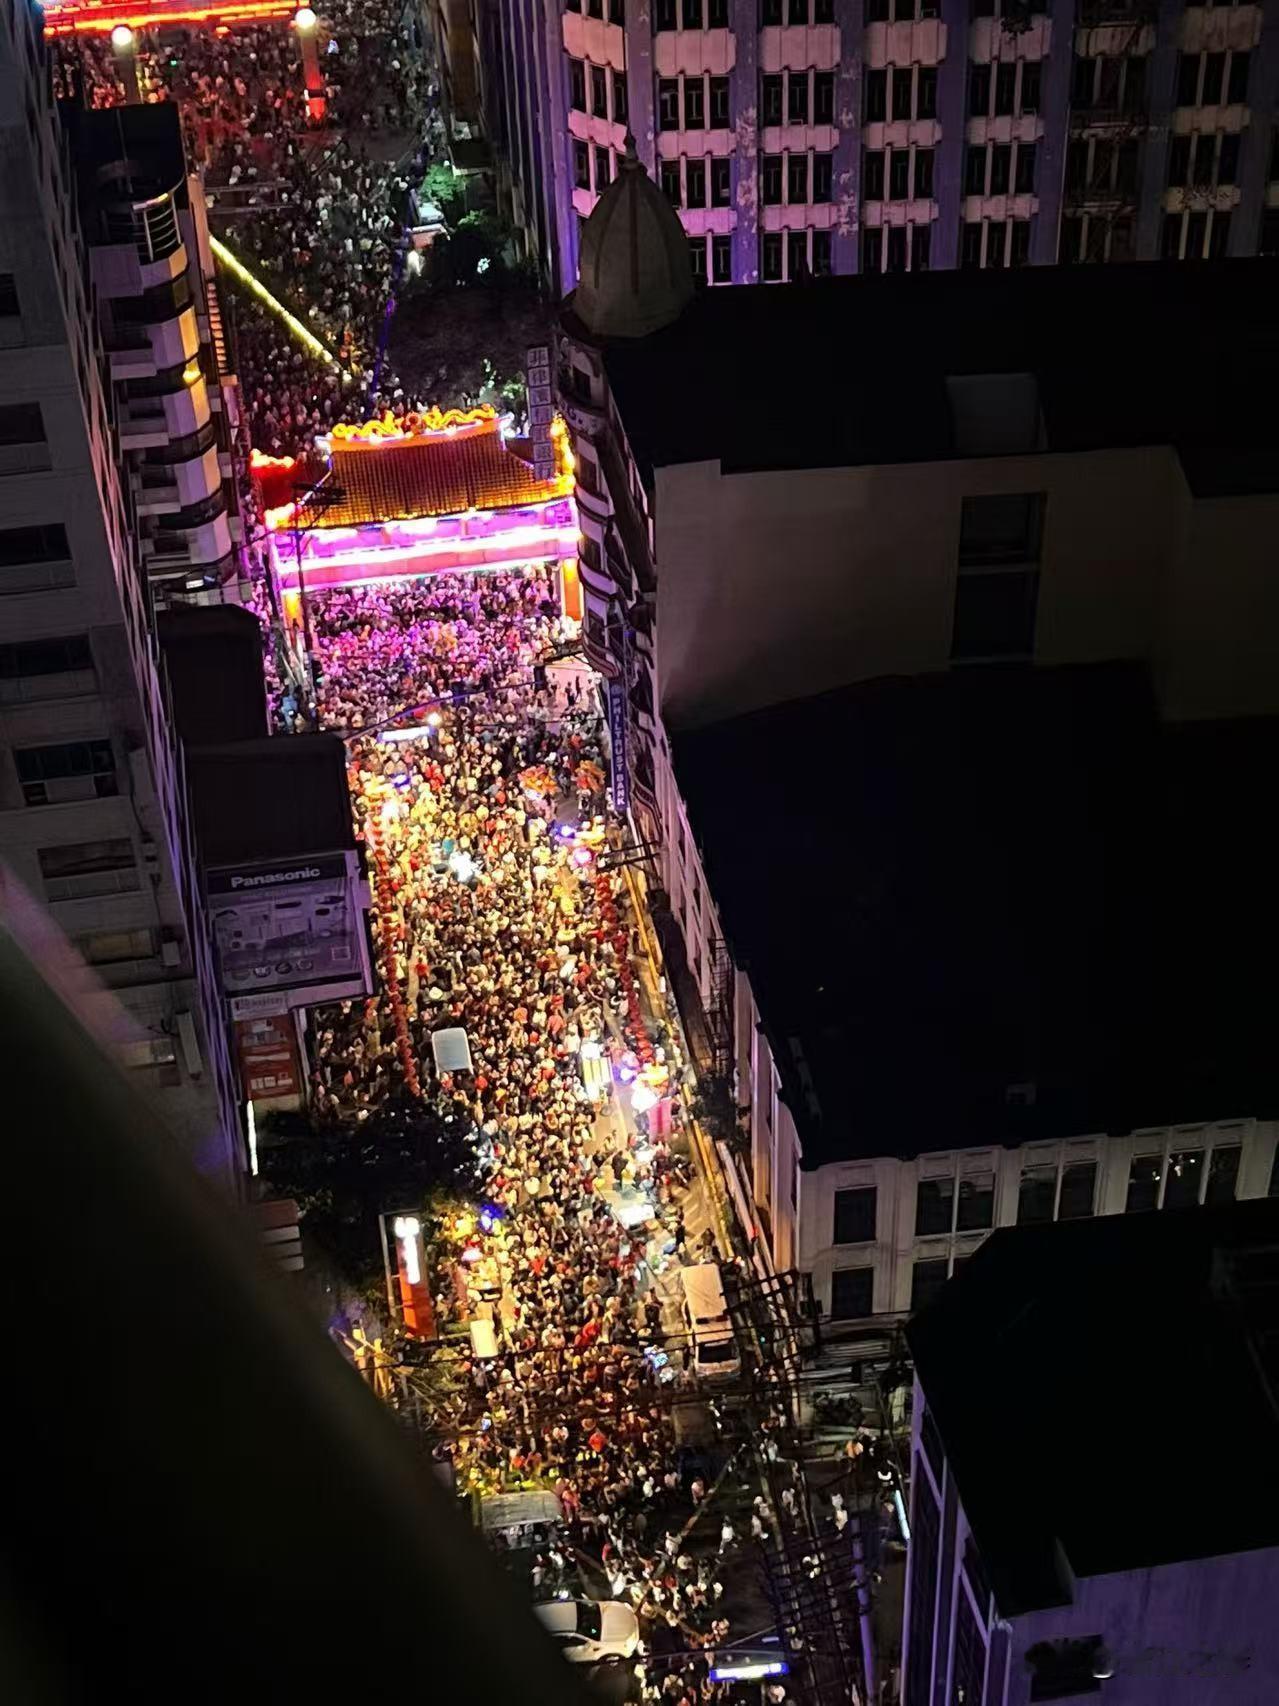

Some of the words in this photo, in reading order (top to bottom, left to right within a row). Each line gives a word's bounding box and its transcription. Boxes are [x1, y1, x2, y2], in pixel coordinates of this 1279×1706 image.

[612, 698, 624, 771] PHILTRUST
[616, 774, 625, 805] BANK
[231, 867, 321, 888] Panasonic
